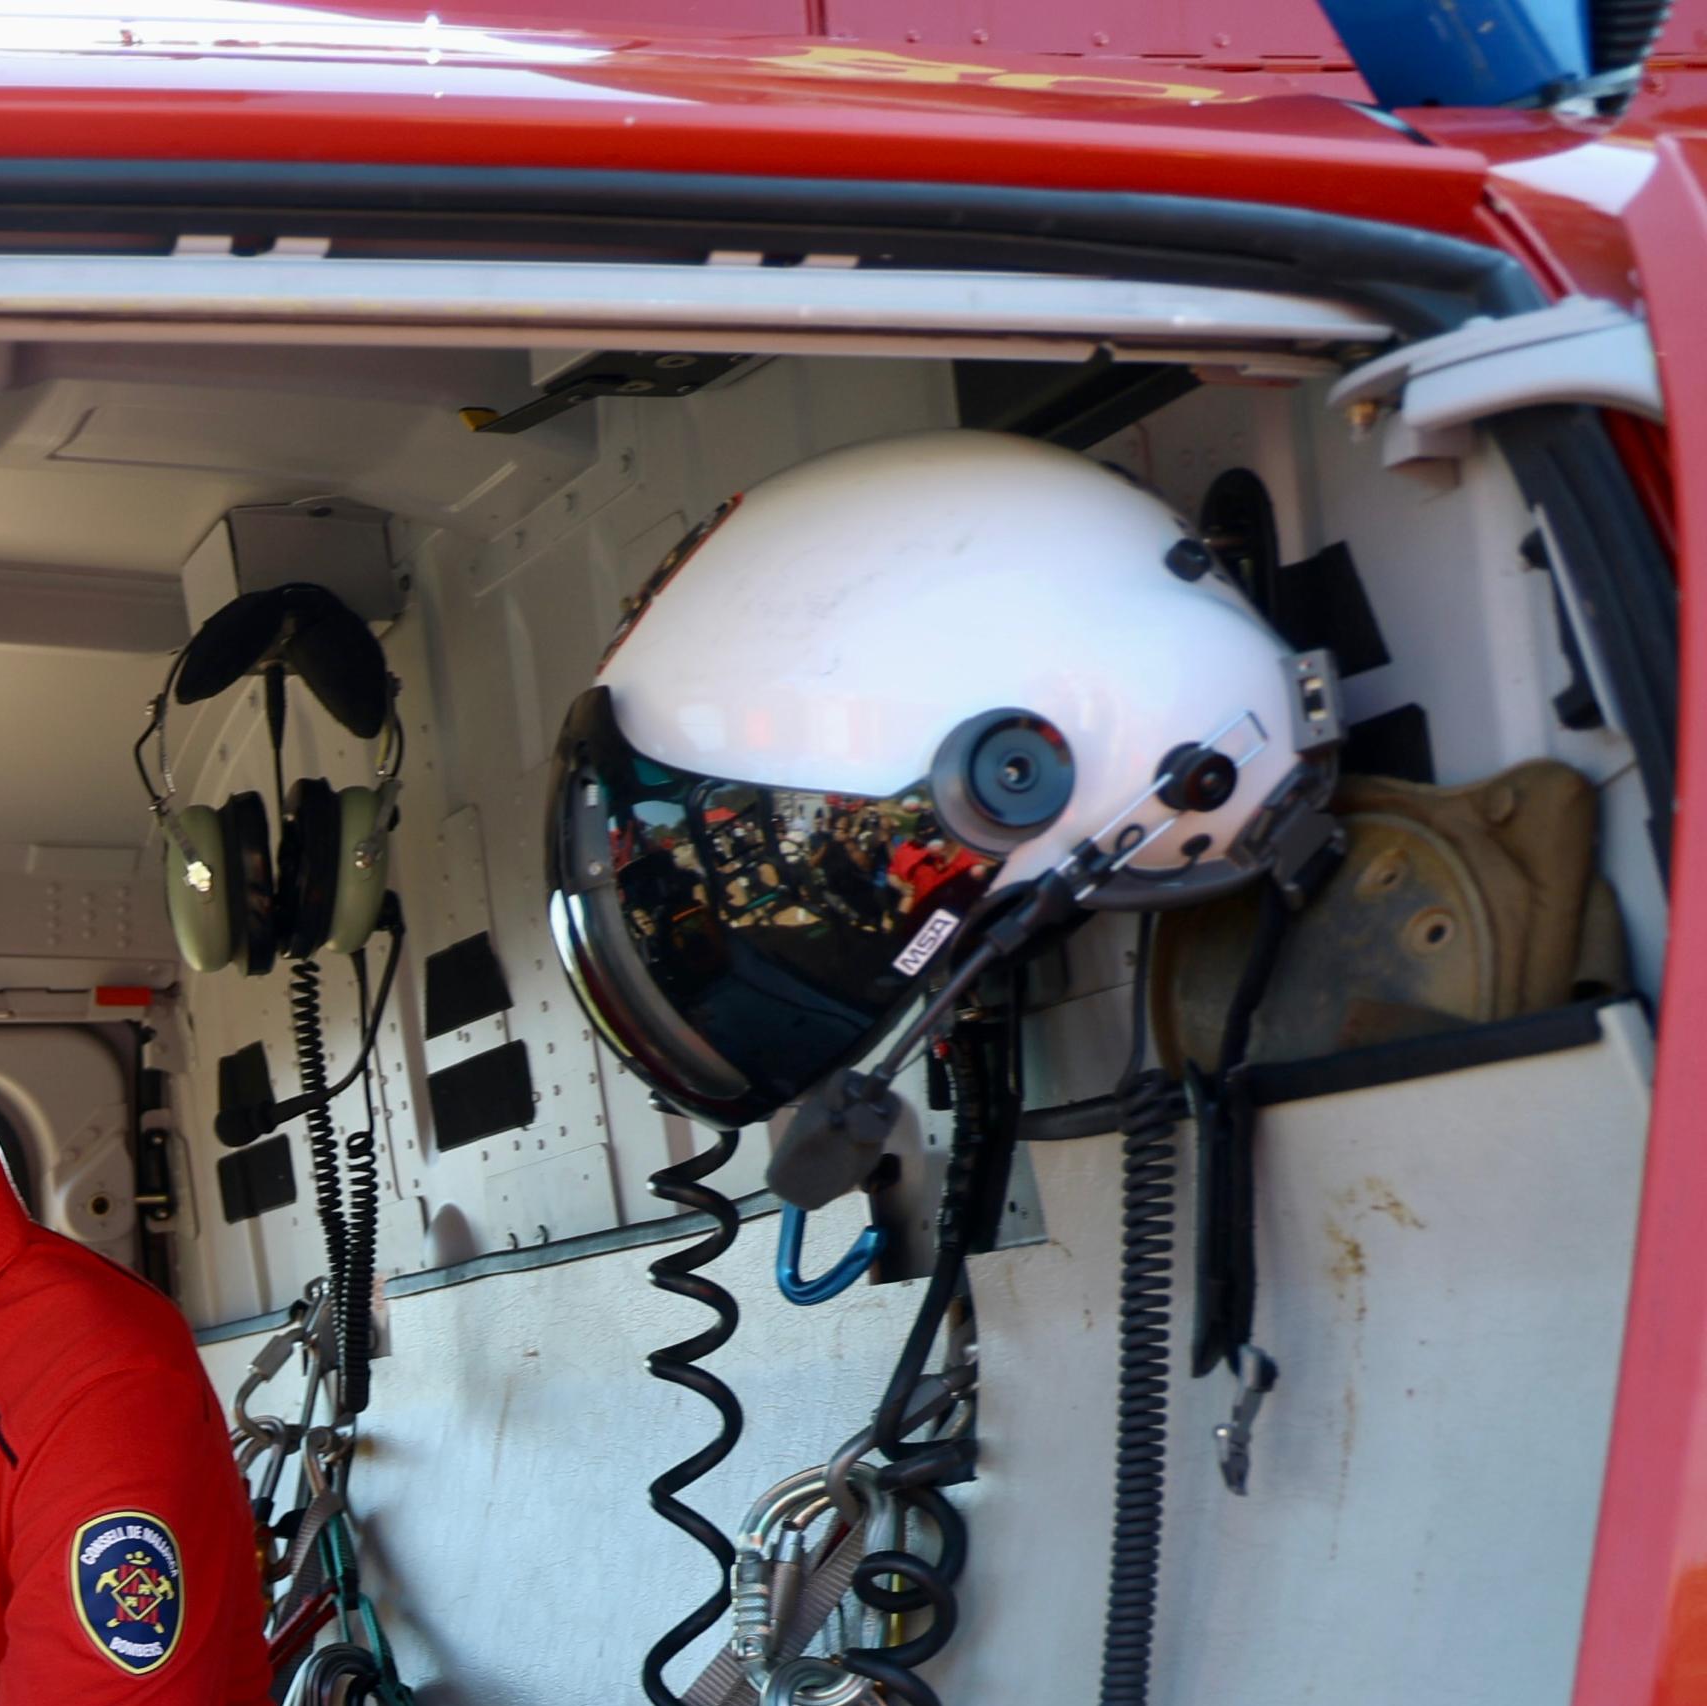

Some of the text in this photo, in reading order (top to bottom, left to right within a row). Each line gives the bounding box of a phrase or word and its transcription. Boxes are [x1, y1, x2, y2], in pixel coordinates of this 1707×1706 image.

[900, 918, 953, 972] MSA
[80, 1527, 124, 1566] CONSELL
[125, 1525, 144, 1540] DE
[110, 1636, 164, 1658] BOMBERS
